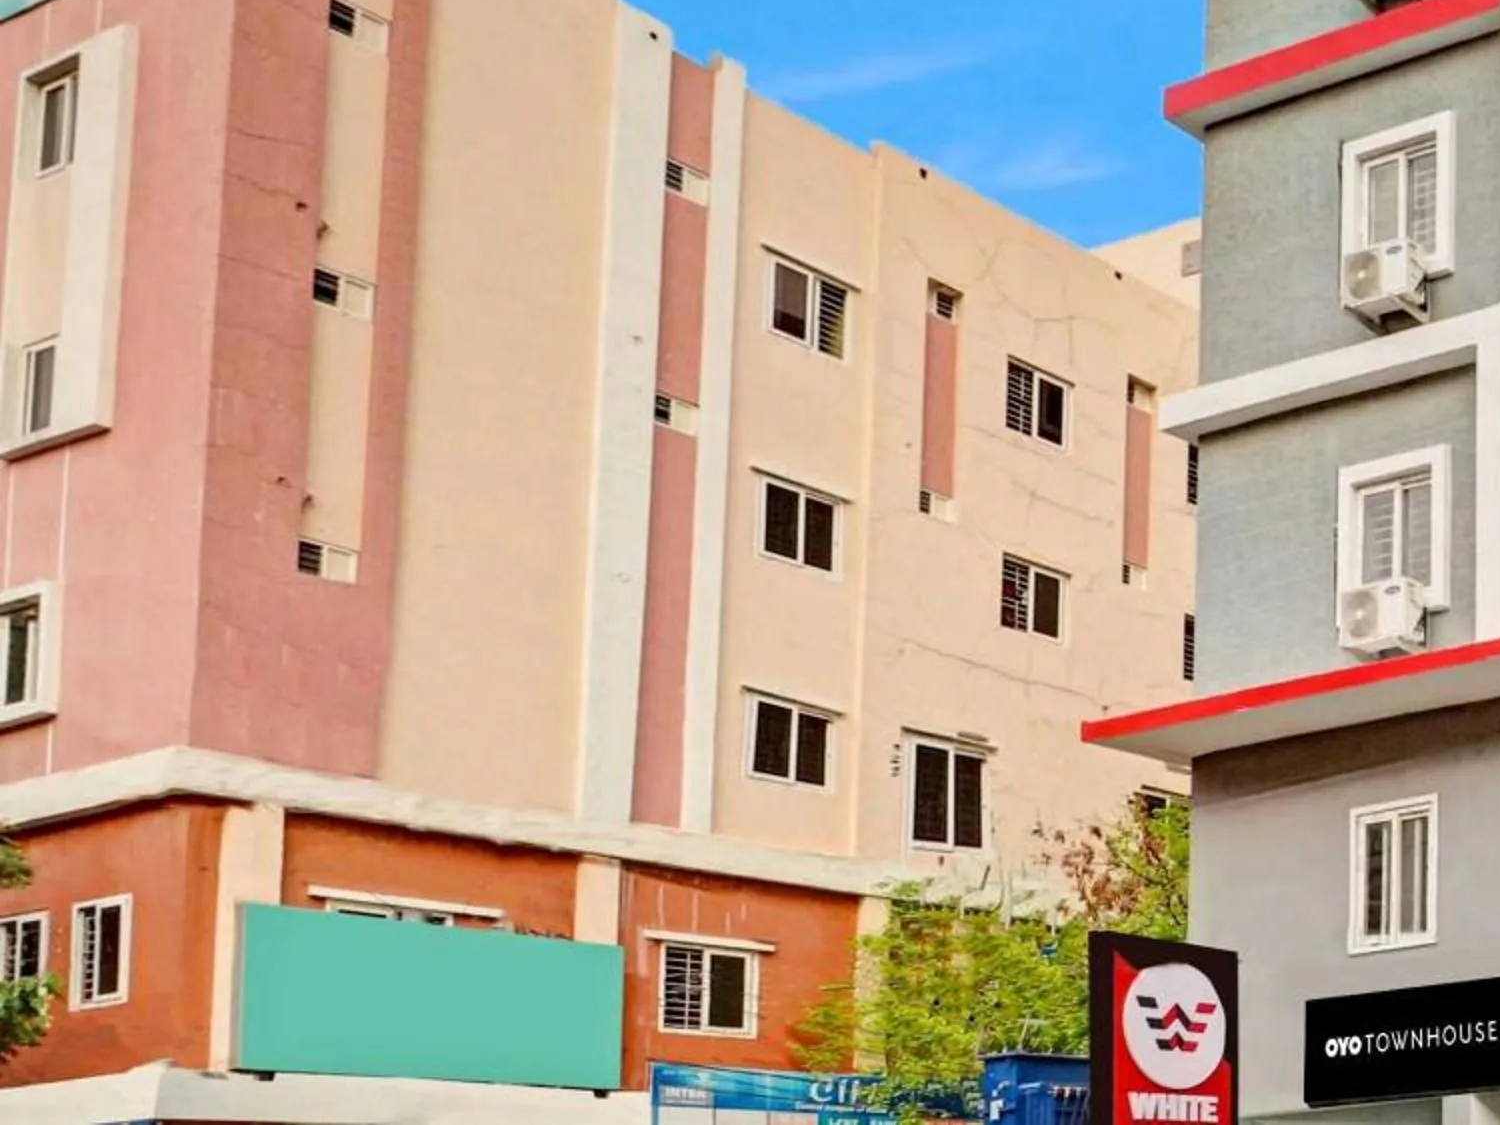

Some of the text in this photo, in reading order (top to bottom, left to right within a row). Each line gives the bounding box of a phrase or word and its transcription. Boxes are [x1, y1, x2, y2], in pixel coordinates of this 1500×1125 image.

[1325, 1020, 1499, 1058] OYO TOWNHOUSE
[1127, 1090, 1219, 1122] WHITE
